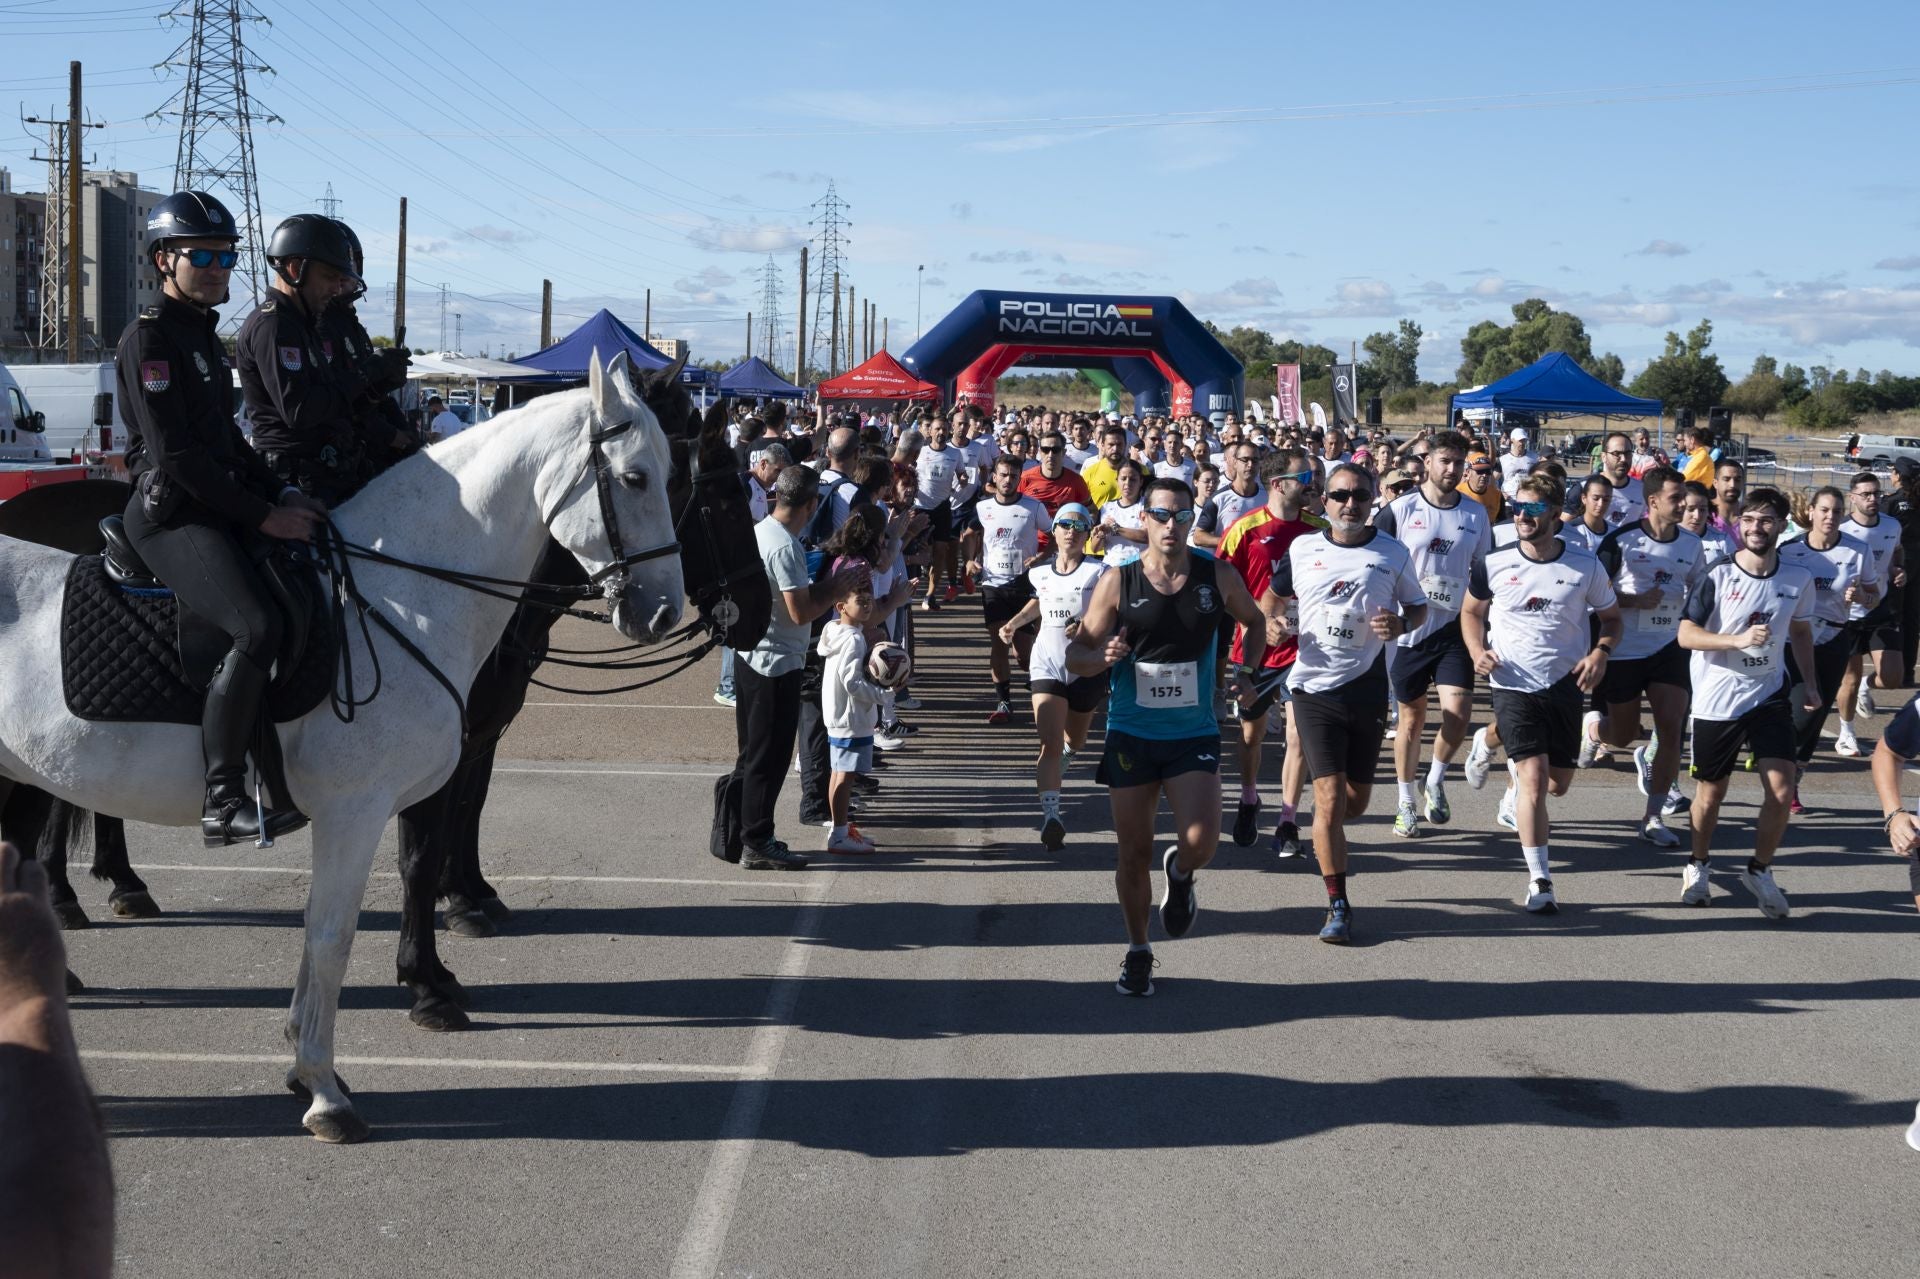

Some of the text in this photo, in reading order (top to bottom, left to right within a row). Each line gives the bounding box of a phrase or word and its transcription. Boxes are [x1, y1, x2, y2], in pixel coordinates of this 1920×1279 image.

[1000, 301, 1122, 318] POLICIA
[999, 317, 1152, 337] NACIONAL
[864, 376, 906, 384] Santander
[1209, 394, 1233, 410] RUTA
[1428, 592, 1451, 602] 1506
[1049, 610, 1070, 618] 1180
[1327, 626, 1354, 639] 1245
[1742, 656, 1768, 667] 1355
[1150, 686, 1182, 697] 1575
